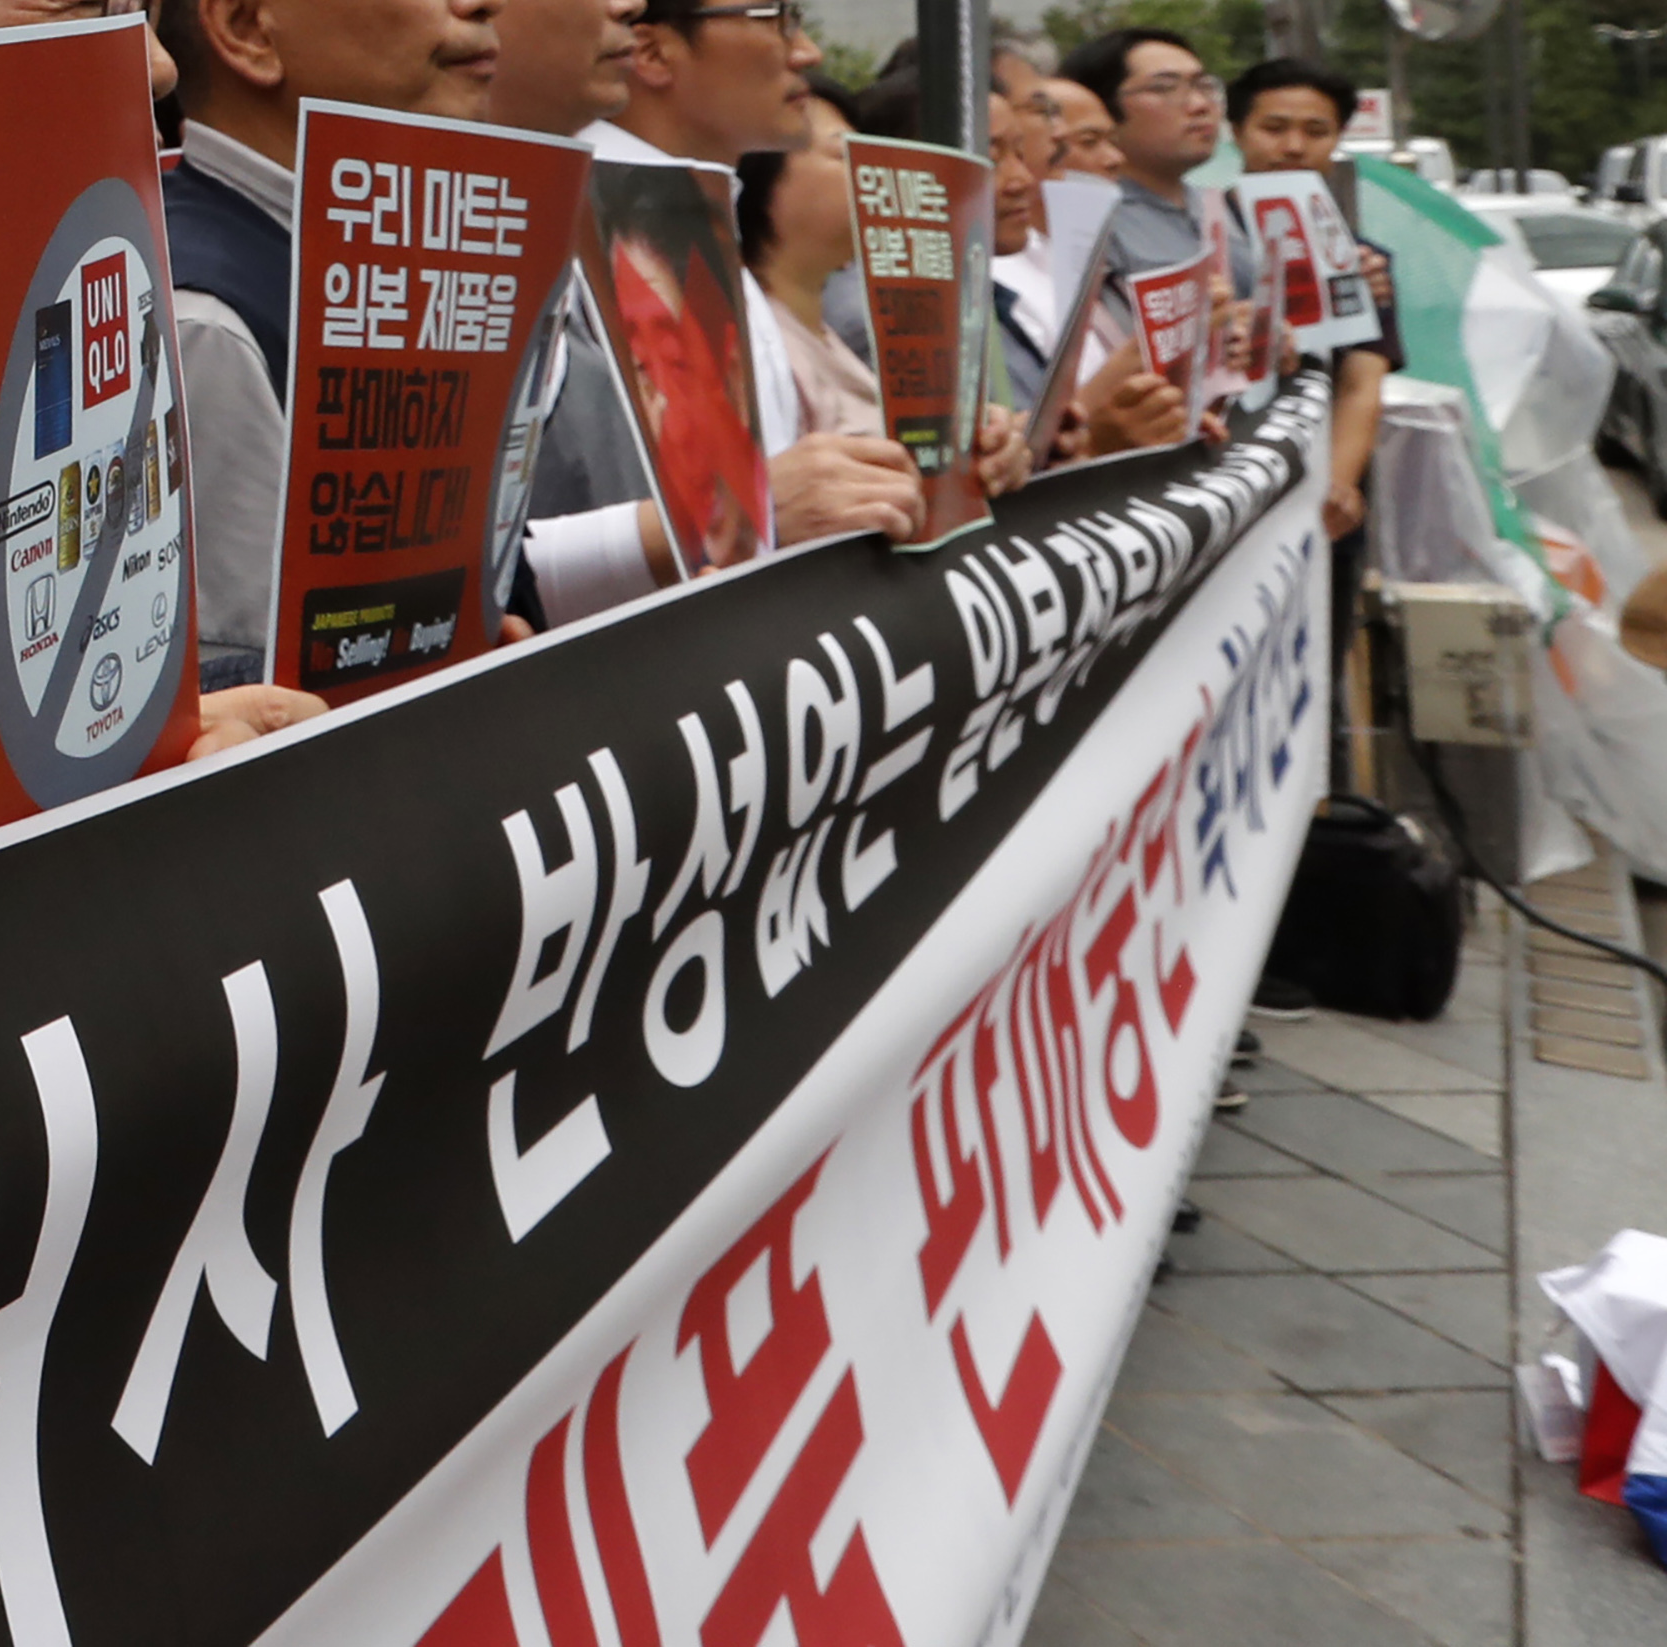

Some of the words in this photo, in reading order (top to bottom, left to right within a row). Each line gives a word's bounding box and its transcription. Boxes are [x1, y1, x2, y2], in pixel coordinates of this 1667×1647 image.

[327, 157, 411, 247] 우리
[422, 167, 528, 258] 마트는
[86, 271, 122, 328] UNI
[322, 262, 408, 350] 일본
[417, 268, 517, 352] 제품을
[88, 329, 127, 394] QLO
[317, 366, 469, 451] 판매하지
[11, 537, 54, 573] Canon
[122, 550, 152, 583] Nikon
[19, 632, 60, 664] HONDA
[336, 629, 392, 670] Selling!
[86, 704, 125, 744] TOYOTA
[482, 617, 935, 1243] 반성없는
